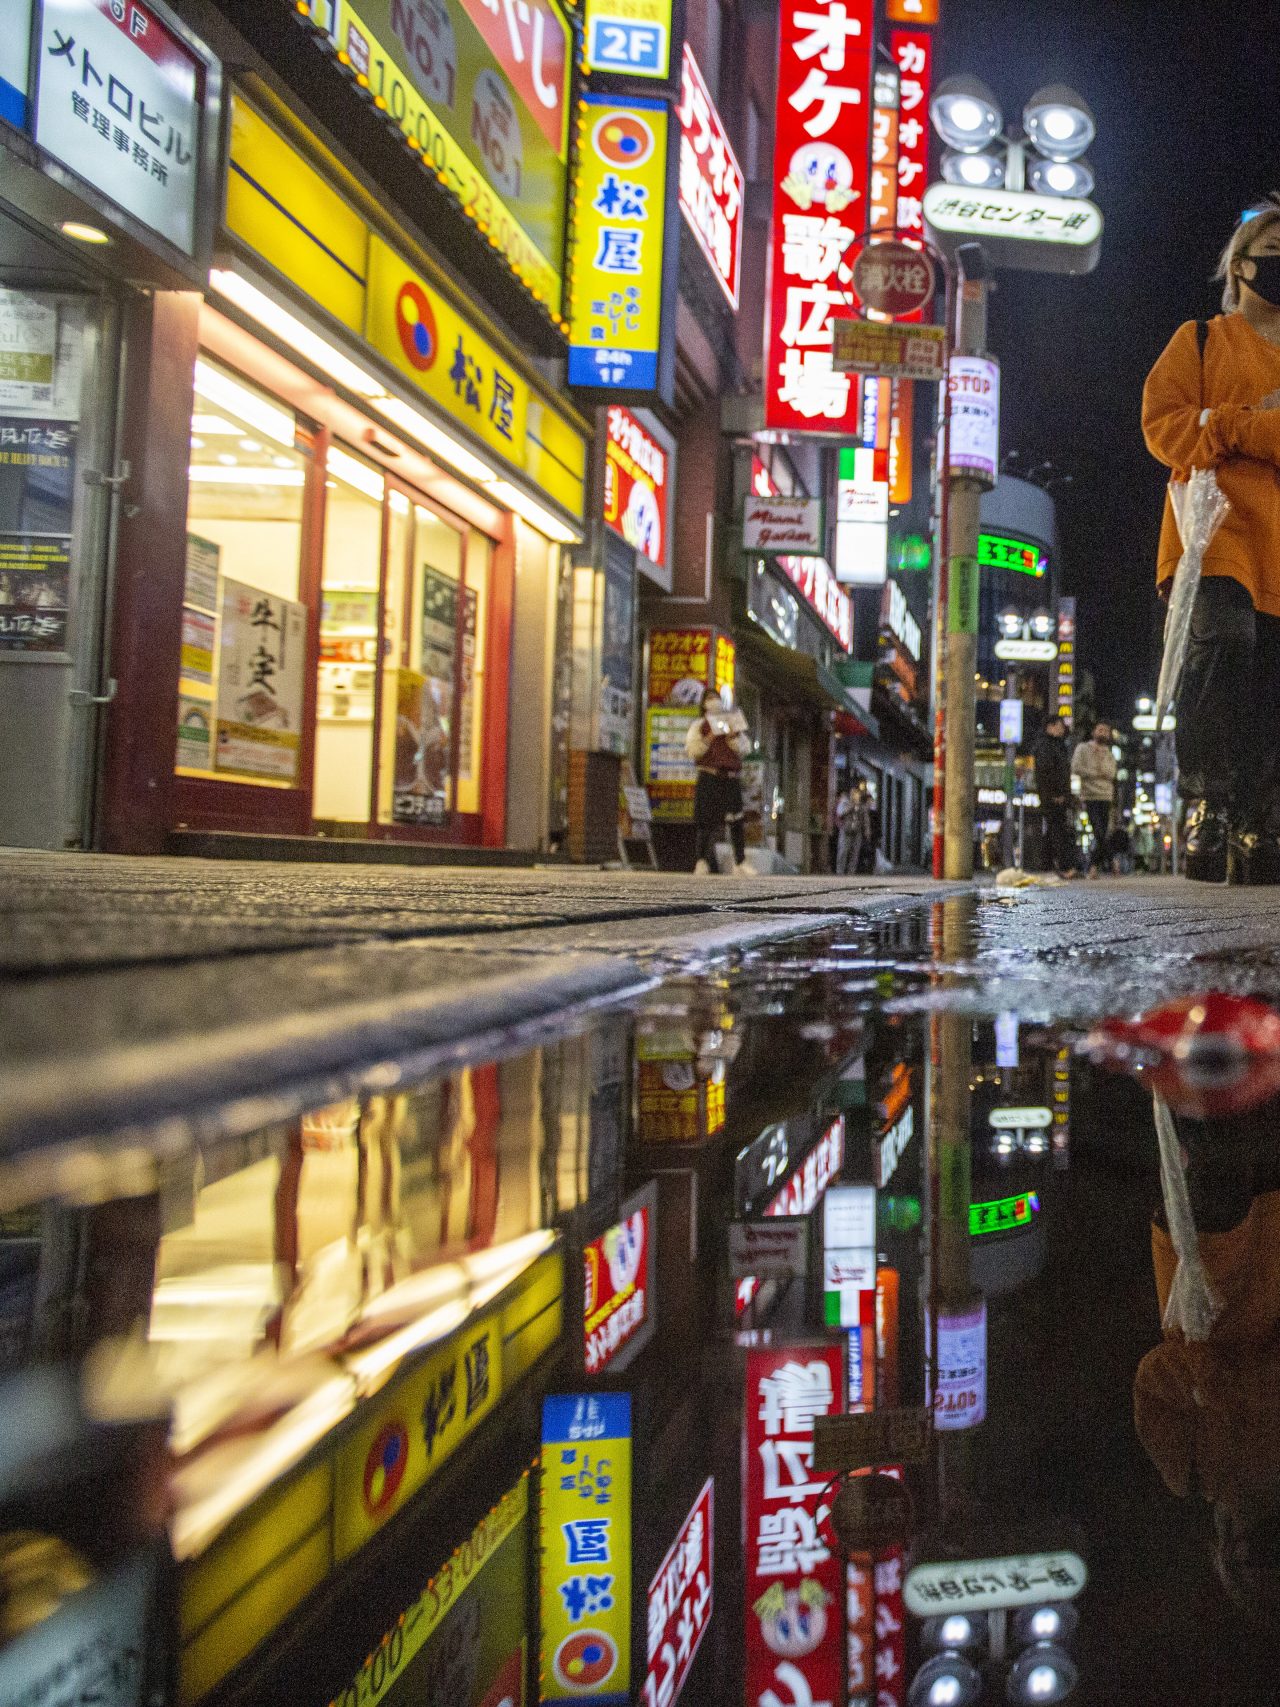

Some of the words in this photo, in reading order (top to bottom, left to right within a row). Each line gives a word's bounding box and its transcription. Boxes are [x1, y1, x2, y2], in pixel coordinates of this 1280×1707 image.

[600, 26, 656, 62] 2F
[786, 0, 861, 138] オケ
[48, 28, 191, 167] メトロビル
[71, 89, 170, 188] 管理事務所
[592, 174, 650, 275] 松屋
[932, 197, 1093, 232] 渋谷センター街
[777, 213, 855, 419] 歌広場
[448, 332, 516, 443] 松屋
[949, 374, 992, 395] STOP
